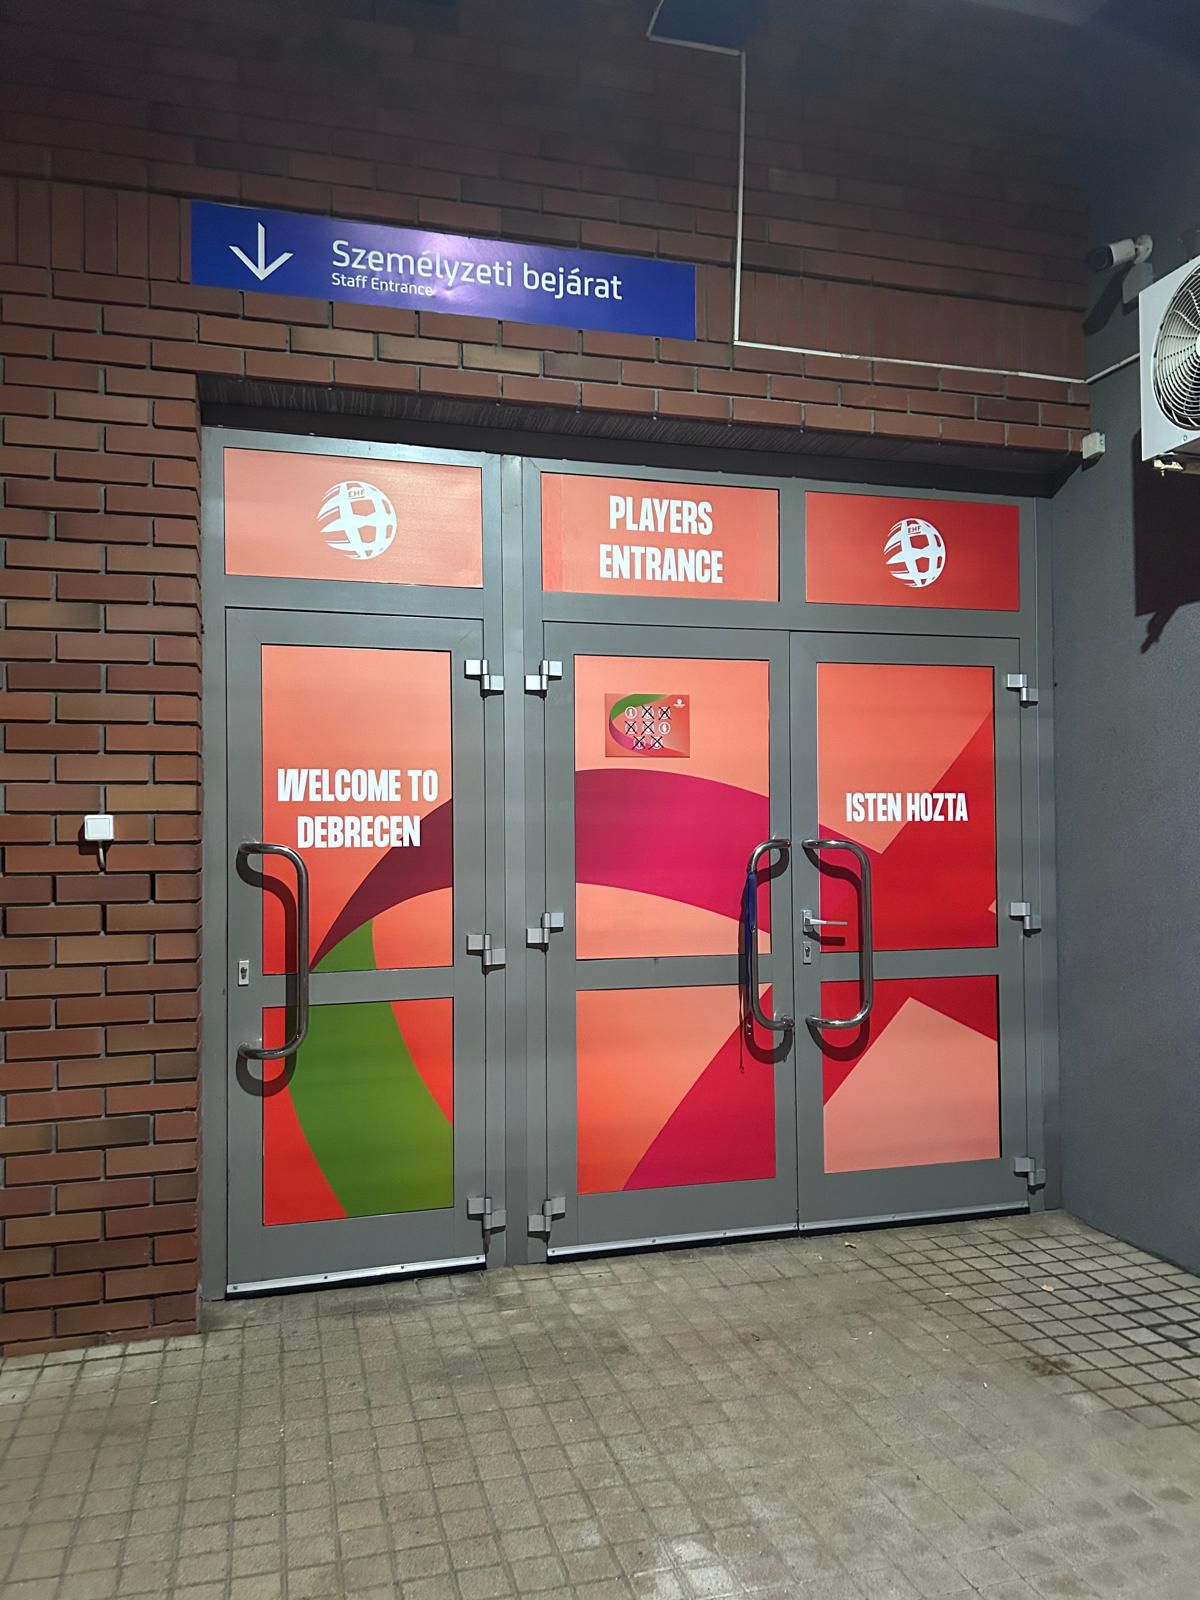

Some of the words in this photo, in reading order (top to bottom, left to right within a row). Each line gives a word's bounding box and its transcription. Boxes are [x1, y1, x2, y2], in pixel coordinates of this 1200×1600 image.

[331, 272, 369, 289] Staff
[371, 277, 434, 297] Entrance
[332, 239, 512, 288] Személyzeti
[523, 261, 622, 300] bejárat
[609, 495, 713, 535] PLAYERS
[599, 543, 724, 584] ENTRANCE
[277, 768, 401, 802] WELCOME
[407, 769, 439, 802] TO
[846, 792, 902, 822] ISTEN
[906, 792, 969, 822] HOZTA
[297, 815, 421, 849] DEBRECEN
